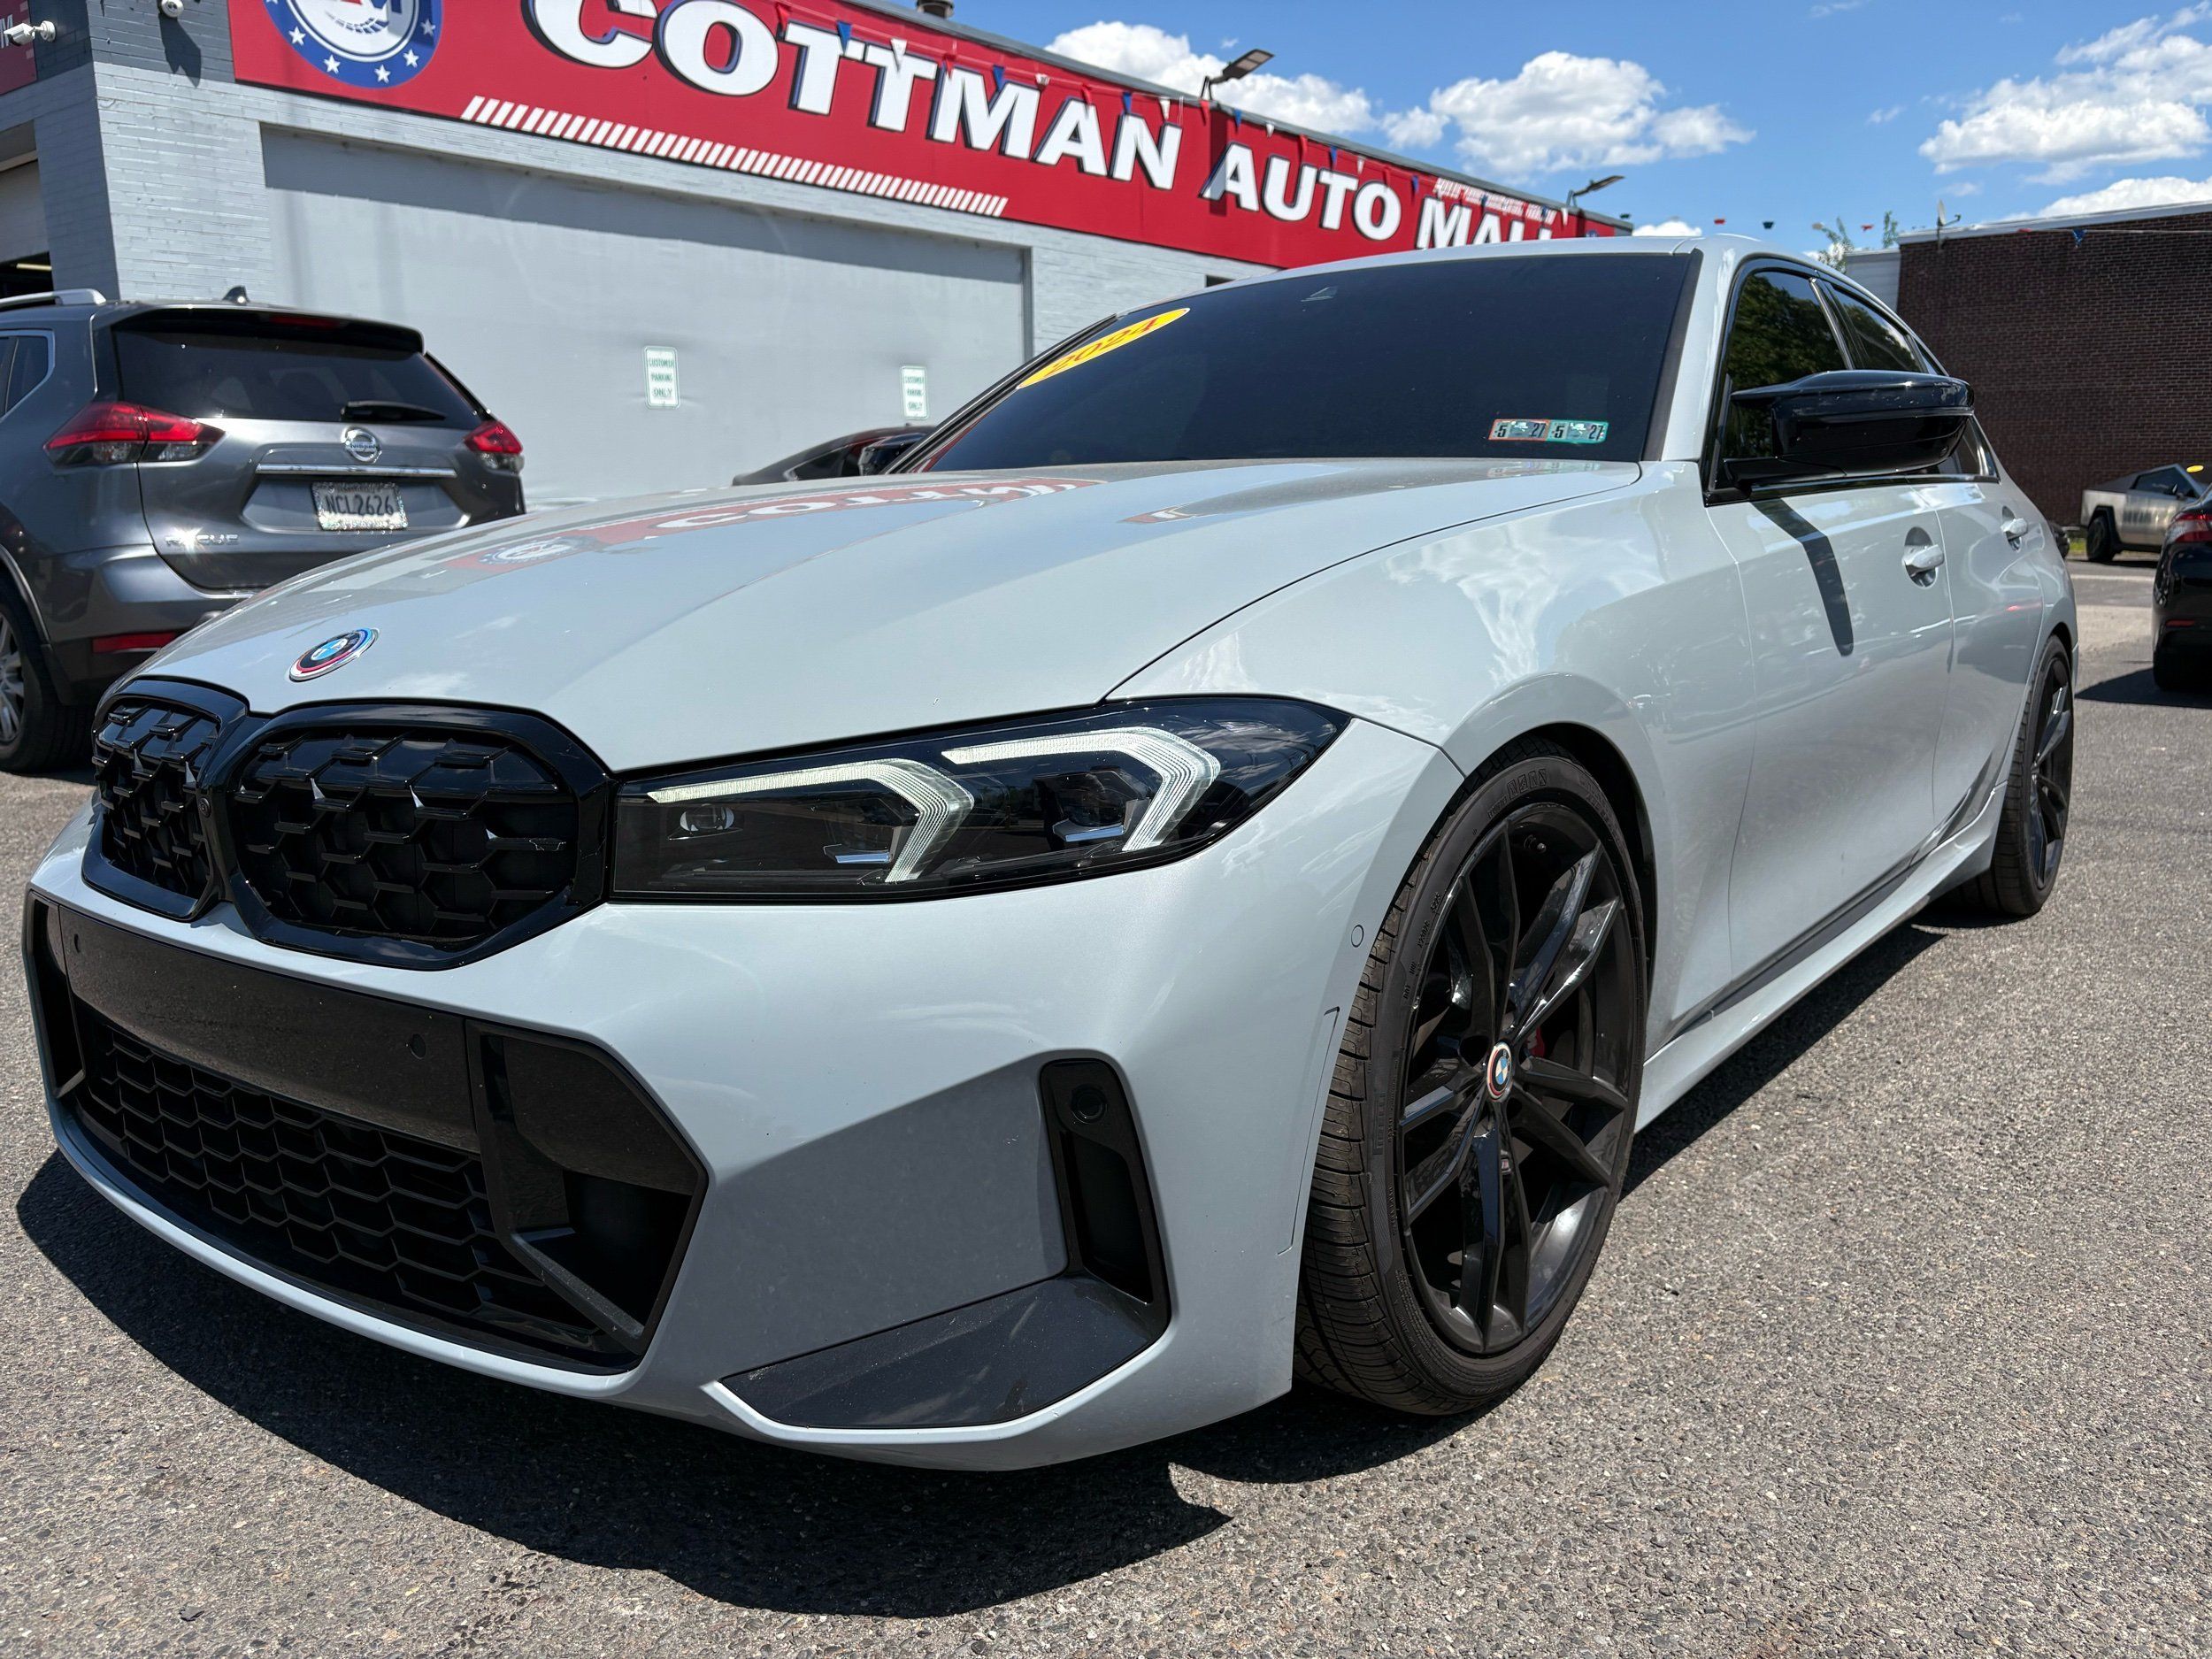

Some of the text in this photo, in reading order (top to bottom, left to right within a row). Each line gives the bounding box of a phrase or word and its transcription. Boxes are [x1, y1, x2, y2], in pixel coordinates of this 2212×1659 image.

[525, 0, 1182, 190] COTTMAN
[1200, 142, 1402, 242] AUTO
[1041, 316, 1161, 378] 2024
[649, 358, 675, 367] CUSTOMER
[651, 373, 674, 382] PARKING
[653, 388, 672, 397] ONLY
[1497, 425, 1508, 438] 5
[1555, 426, 1564, 439] 5
[325, 495, 396, 517] NCL2626
